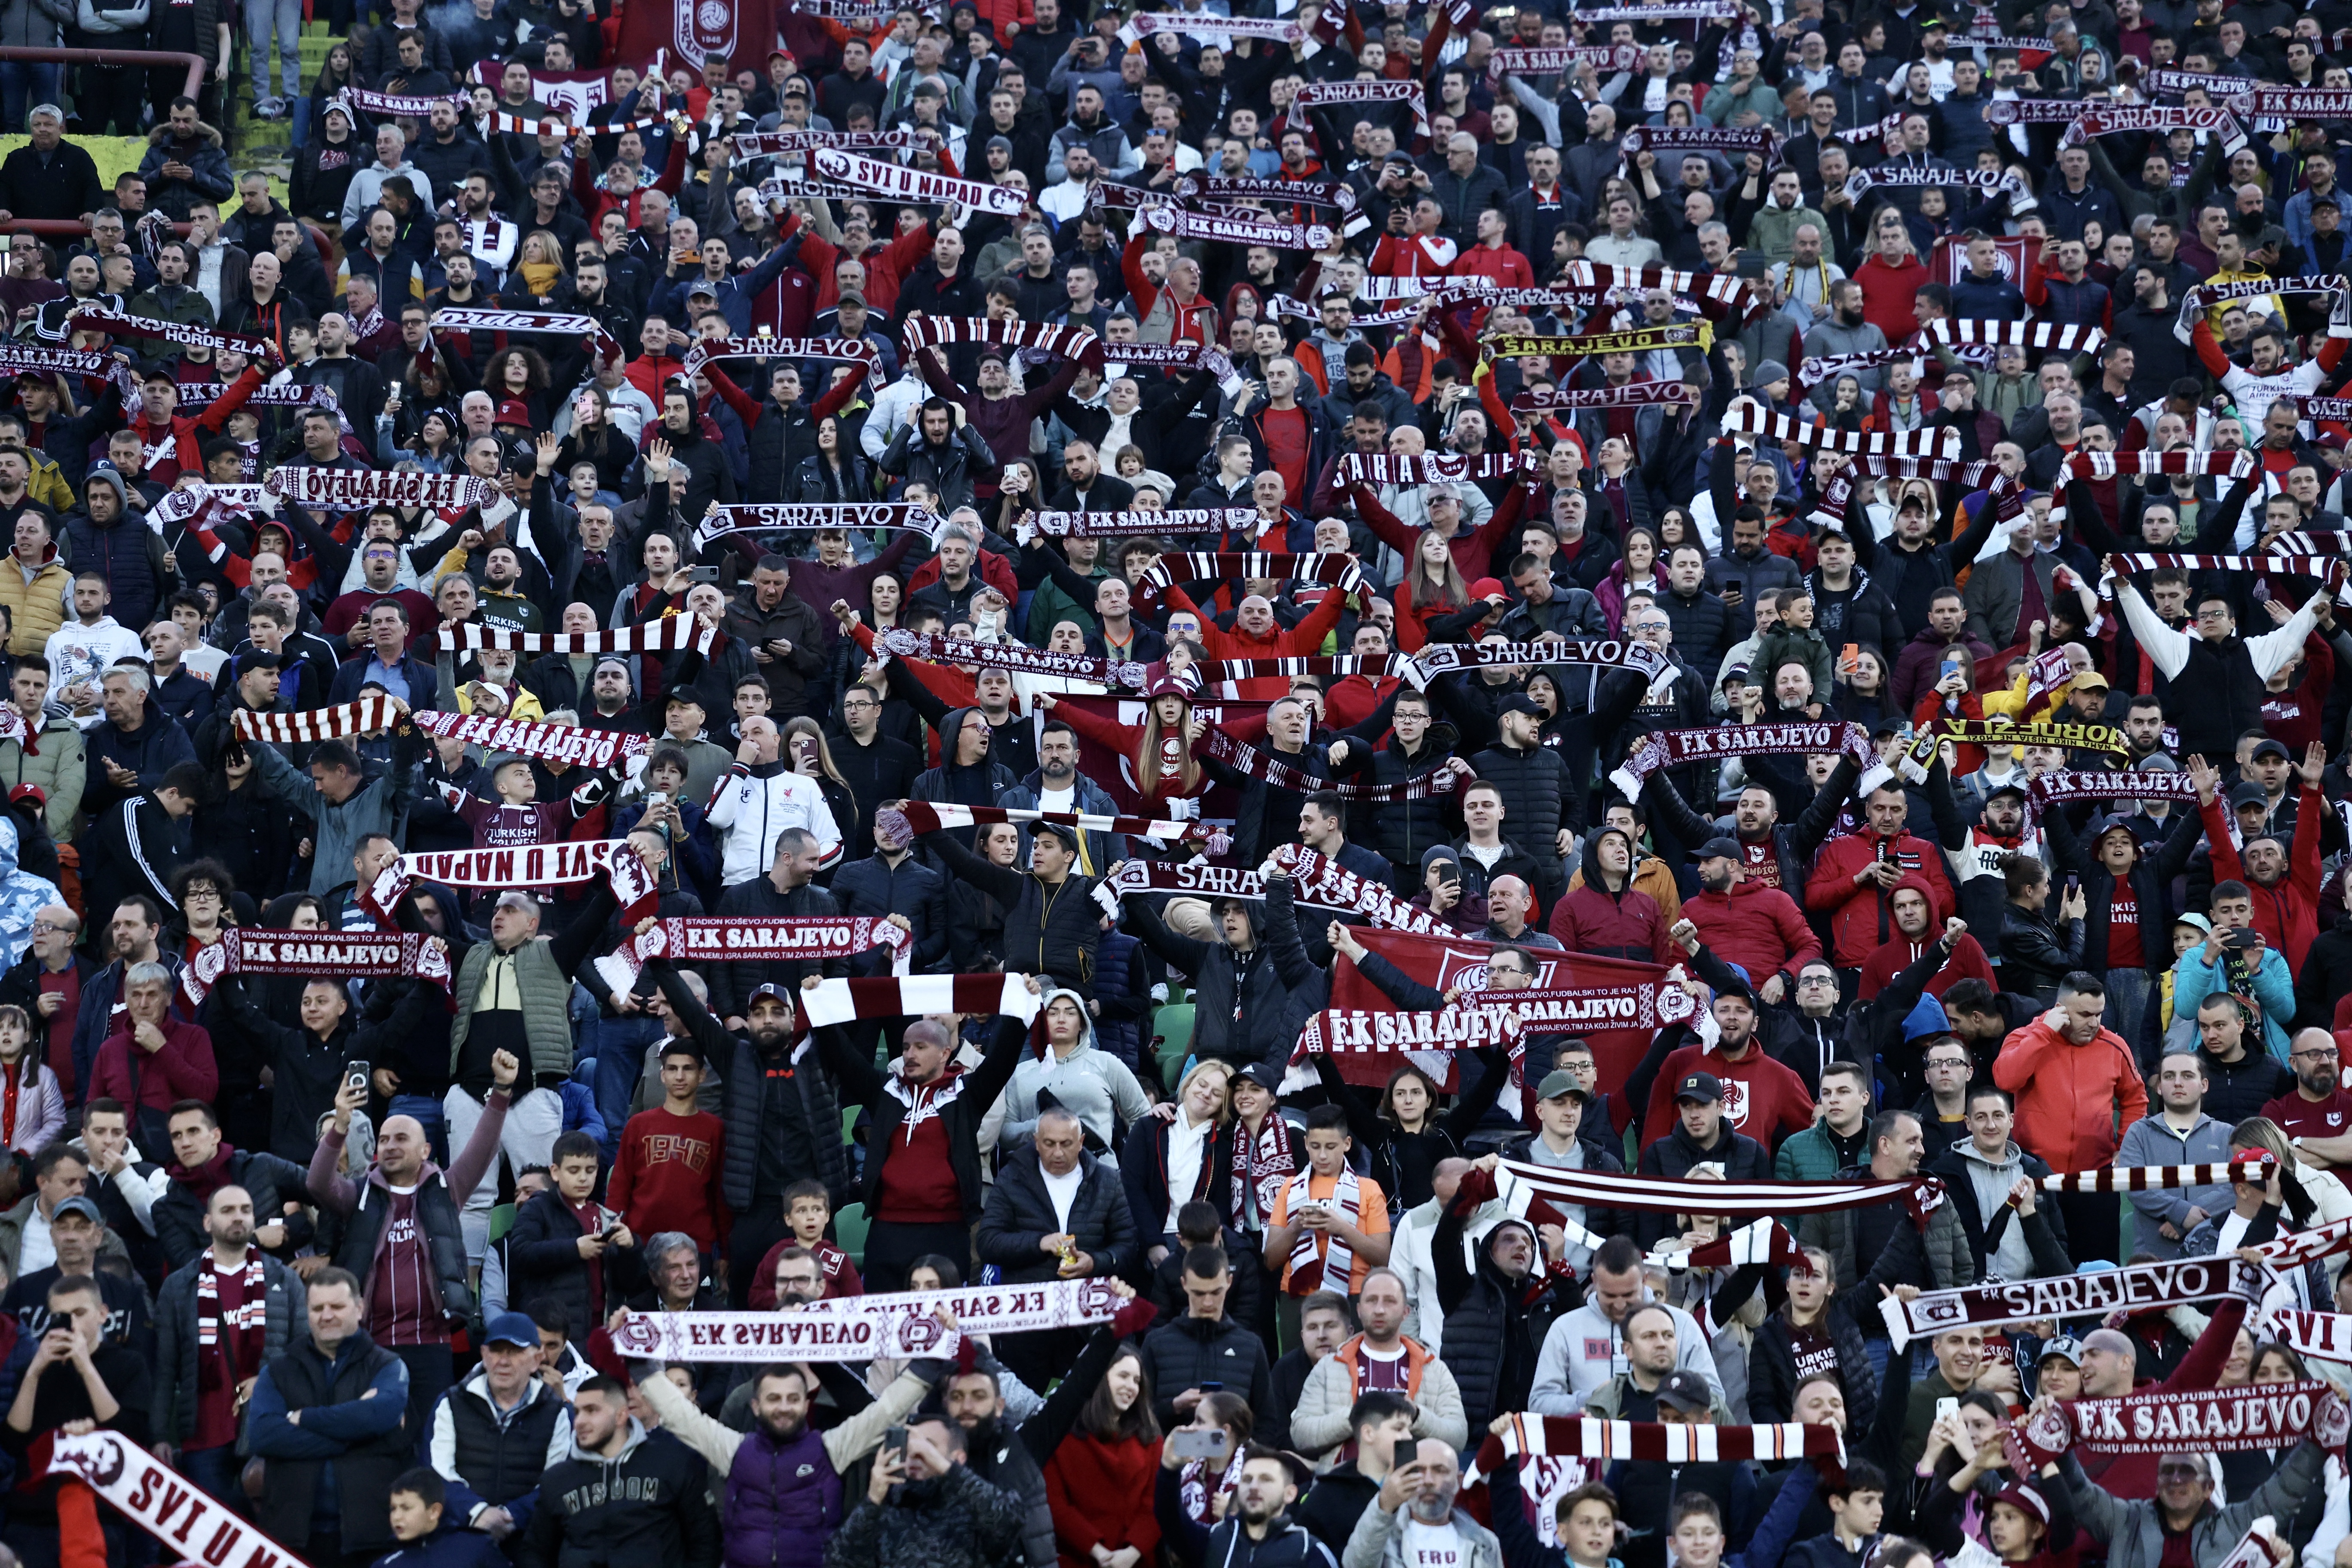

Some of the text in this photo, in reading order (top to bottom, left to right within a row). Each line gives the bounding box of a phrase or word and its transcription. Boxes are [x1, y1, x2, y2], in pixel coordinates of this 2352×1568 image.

[1193, 18, 1274, 29] SARAJEVO
[1505, 52, 1528, 69] F.K
[1308, 84, 1411, 103] SARAJEVO
[2262, 94, 2288, 111] F.K
[2096, 107, 2216, 130] SARAJEVO
[777, 132, 902, 150] SARAJEVO
[1678, 131, 1761, 144] SARAJEVO
[858, 161, 982, 206] SVI U NAPAD
[1236, 179, 1326, 195] SARAJEVO
[1882, 167, 2000, 187] SARAJEVO
[1188, 218, 1211, 233] F.K
[1213, 222, 1292, 242] SARAJEVO
[2214, 274, 2341, 300] SARAJEVO
[165, 328, 265, 356] HORDE ZLA
[726, 337, 864, 358] SARAJEVO
[1504, 334, 1652, 353] SARAJEVO
[0, 349, 102, 370] SARAJEVO
[180, 384, 206, 400] F.K
[1531, 383, 1685, 406] SARAJEVO
[1444, 464, 1461, 473] 1946
[758, 505, 894, 526] SARAJEVO
[1087, 509, 1209, 527] F.K SARAJEVO
[937, 636, 972, 646] STADION
[973, 640, 1008, 652] KOŠEVO,
[1011, 646, 1057, 657] FUDBALSKI
[1473, 640, 1622, 663] SARAJEVO
[944, 642, 1094, 674] F.K SARAJEVO
[944, 656, 969, 664] NJEMU
[1072, 672, 1094, 680] ŽIVIM
[398, 725, 412, 737] HZ
[1669, 728, 1705, 737] STADION
[1706, 726, 1743, 735] KOŠEVO,
[1947, 718, 2015, 736] ZLA
[457, 719, 615, 763] F.K SARAJEVO
[1678, 726, 1831, 755] F.K SARAJEVO
[2000, 735, 2013, 743] NE
[2020, 735, 2048, 745] NIŠTA
[2054, 738, 2077, 747] NIKO
[2082, 741, 2111, 751] NAMA
[2040, 772, 2196, 794] F.K SARAJEVO
[2049, 793, 2072, 802] NJEMU
[489, 828, 537, 838] TURKISH
[1157, 862, 1174, 872] F.K.
[1322, 868, 1360, 903] F.K
[242, 931, 277, 940] STADION
[686, 926, 851, 948] F.K SARAJEVO
[242, 941, 400, 965] F.K SARAJEVO
[823, 948, 842, 957] ŽIVIM
[1479, 991, 1514, 1001] STADION
[1518, 996, 1636, 1021] SARAJEVO
[1330, 1011, 1520, 1047] F.K SARAJEVO
[1610, 1019, 1628, 1029] ŽIVIM
[642, 1134, 711, 1176] 1946
[1981, 1263, 2209, 1317] FK SARAJEVO
[1795, 1346, 1836, 1368] URKIS
[2259, 1380, 2327, 1394] TO JE RAJ
[2076, 1393, 2312, 1440] F.K SARAJEVO
[2122, 1436, 2281, 1453] IGRA TIM ZA KOJI
[561, 1476, 659, 1516] WISDOM
[129, 1467, 242, 1566] SVI U
